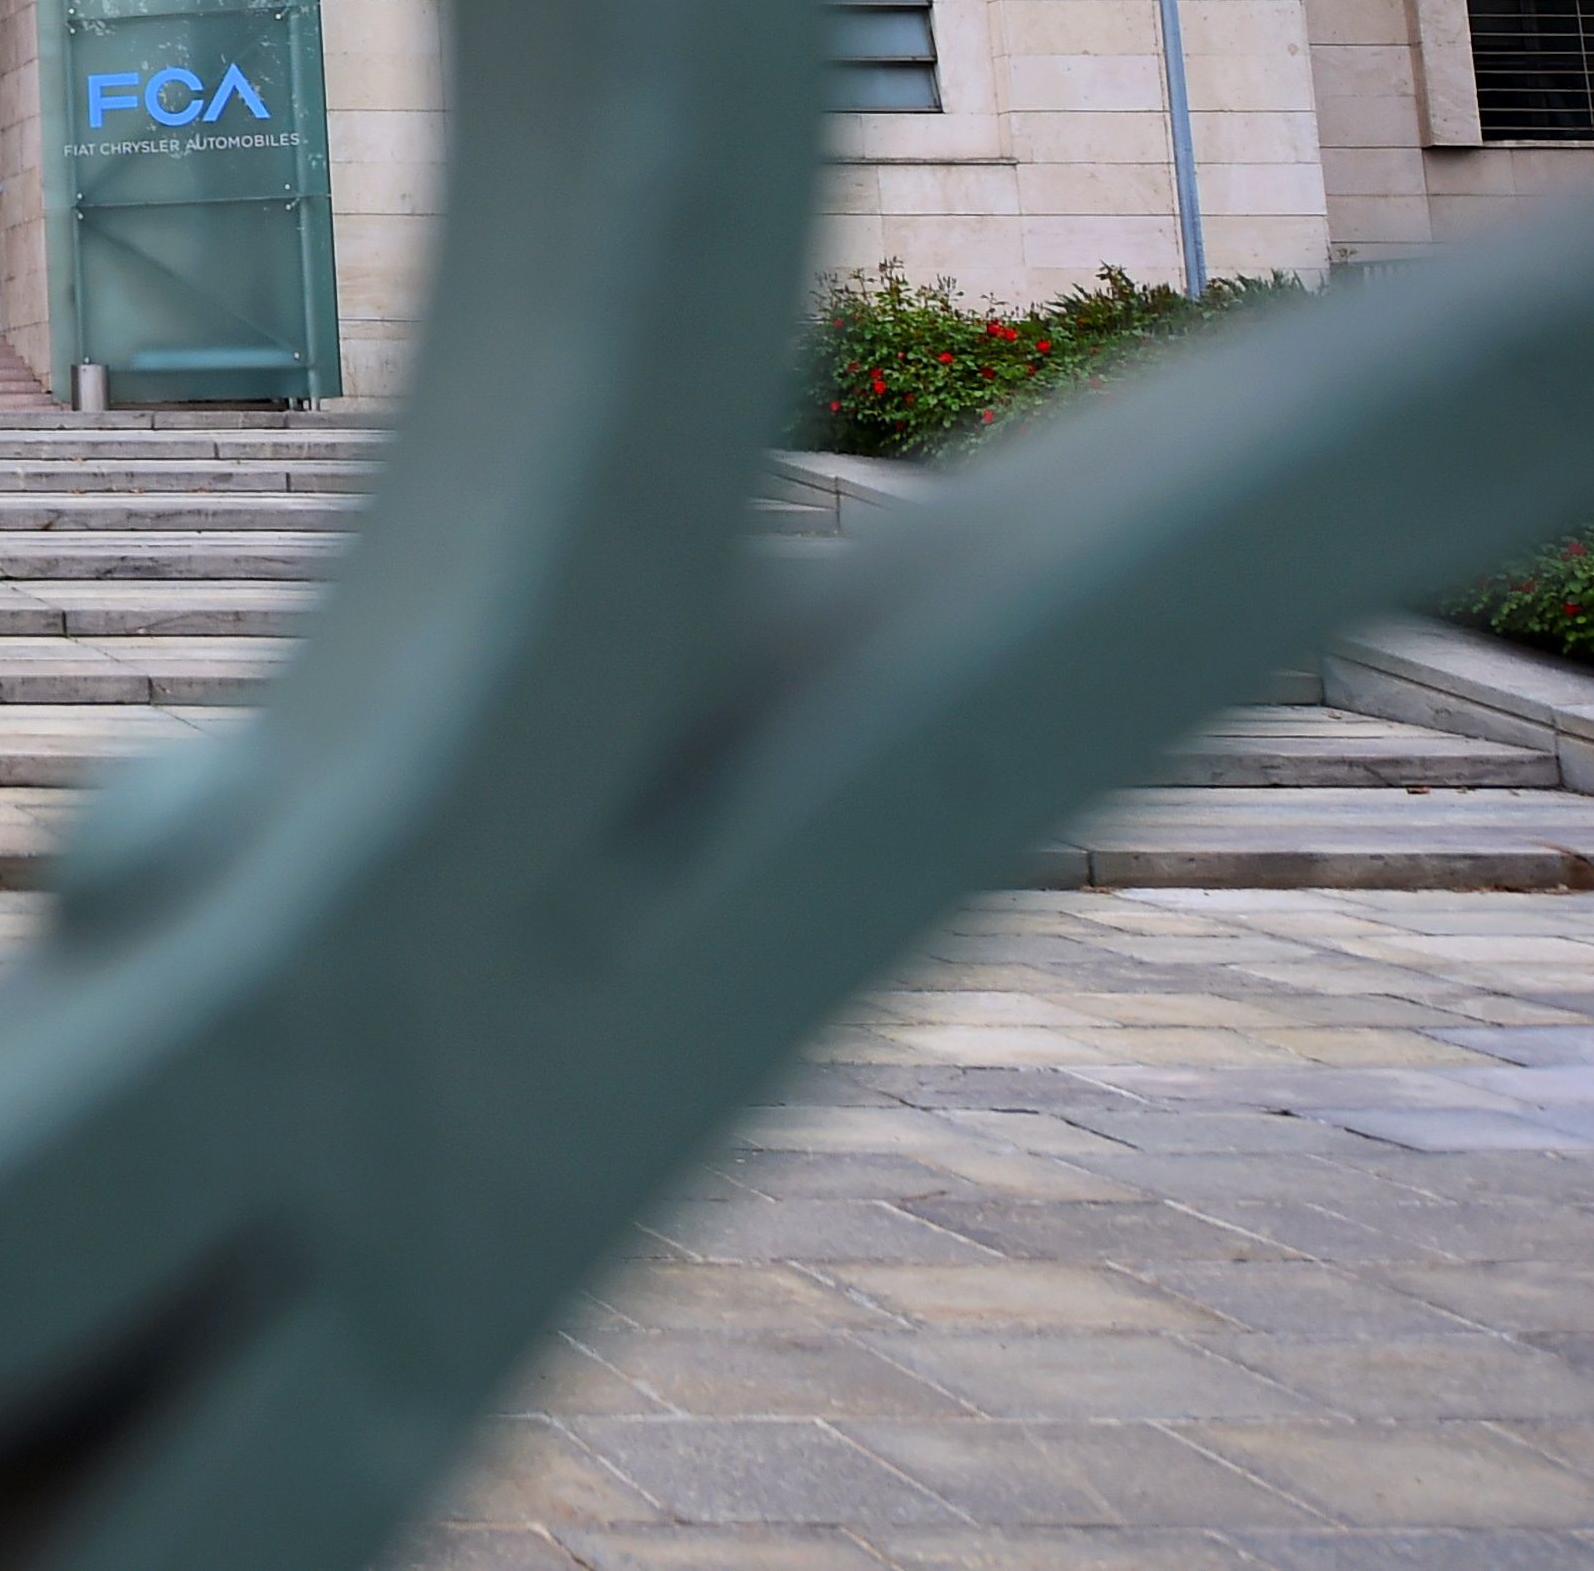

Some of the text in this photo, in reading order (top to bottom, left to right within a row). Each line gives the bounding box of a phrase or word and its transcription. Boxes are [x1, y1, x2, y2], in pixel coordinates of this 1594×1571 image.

[87, 61, 271, 129] FCA
[63, 132, 300, 157] FIAT CHRYSLER AUTOMOBILES
